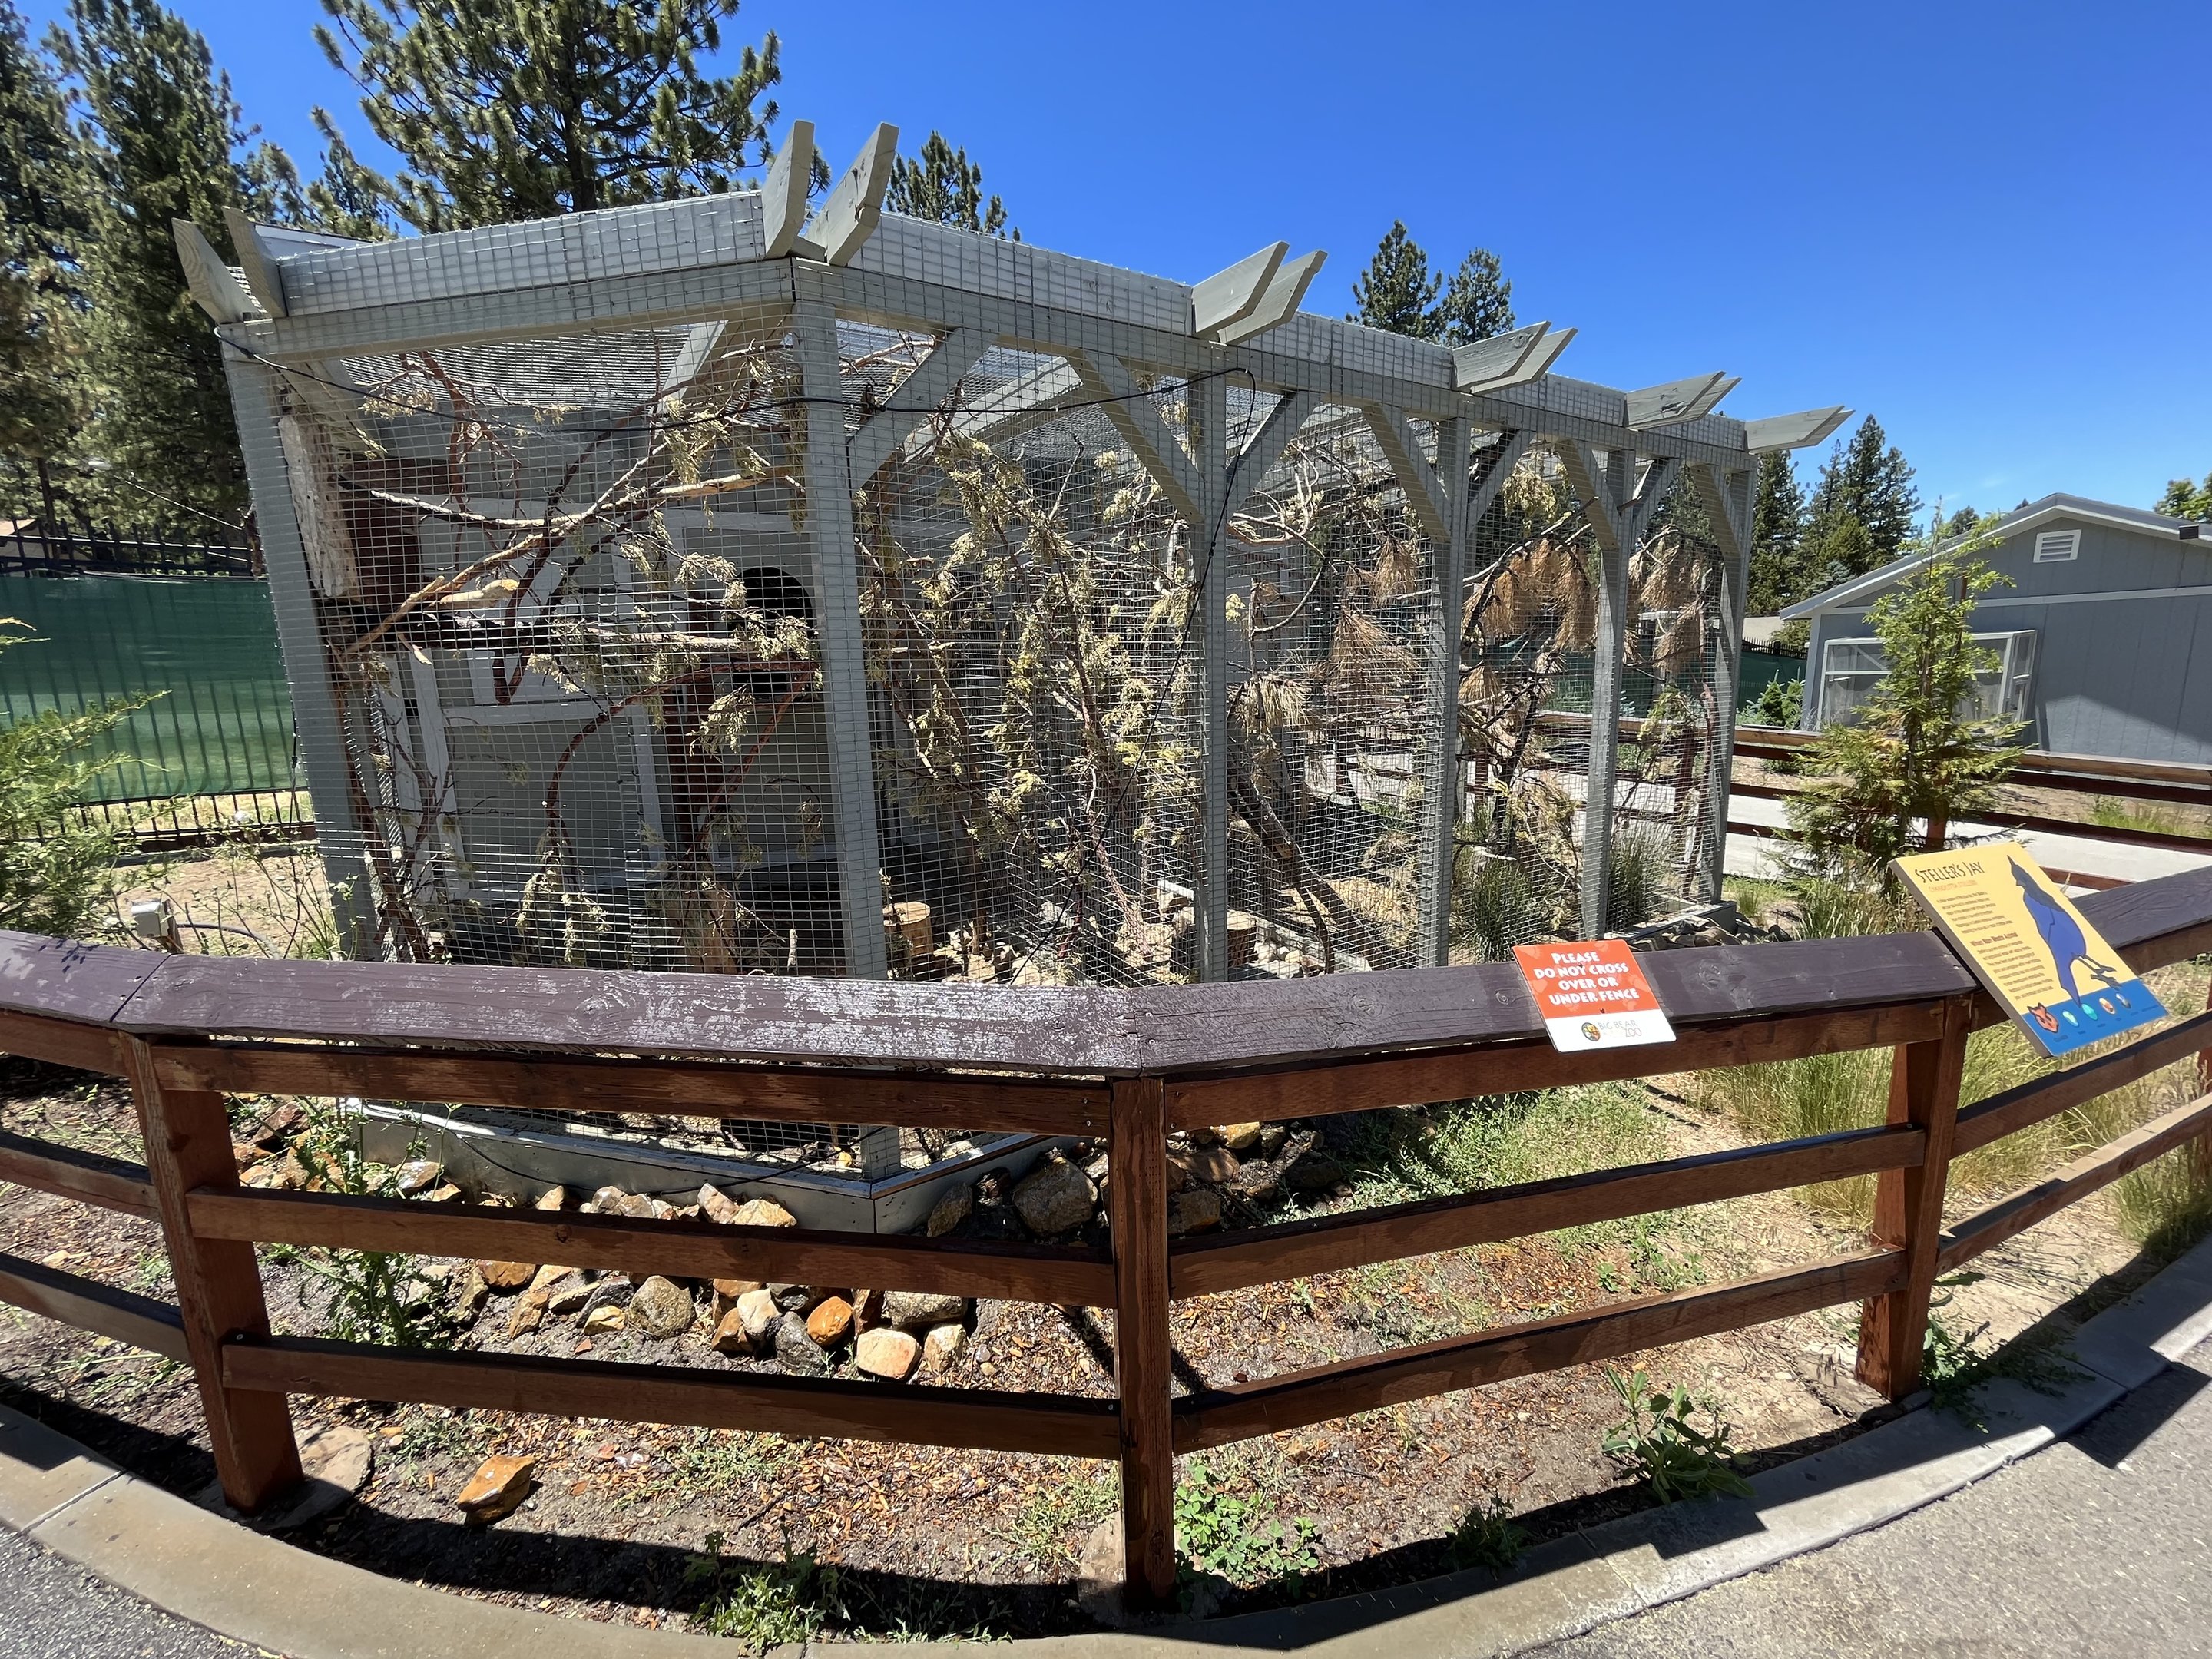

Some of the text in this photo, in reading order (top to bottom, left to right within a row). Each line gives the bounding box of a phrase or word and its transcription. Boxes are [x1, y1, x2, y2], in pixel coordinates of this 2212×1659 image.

[1915, 862, 1985, 883] STELLER'S JAY
[1551, 952, 1600, 964] PLEASE
[1534, 963, 1629, 979] DO NOT CROSS
[1558, 977, 1619, 990] OVER OR
[1549, 988, 1639, 1005] UNDER FENCE
[1614, 1020, 1637, 1028] BEAR
[1624, 1028, 1641, 1037] ZOO
